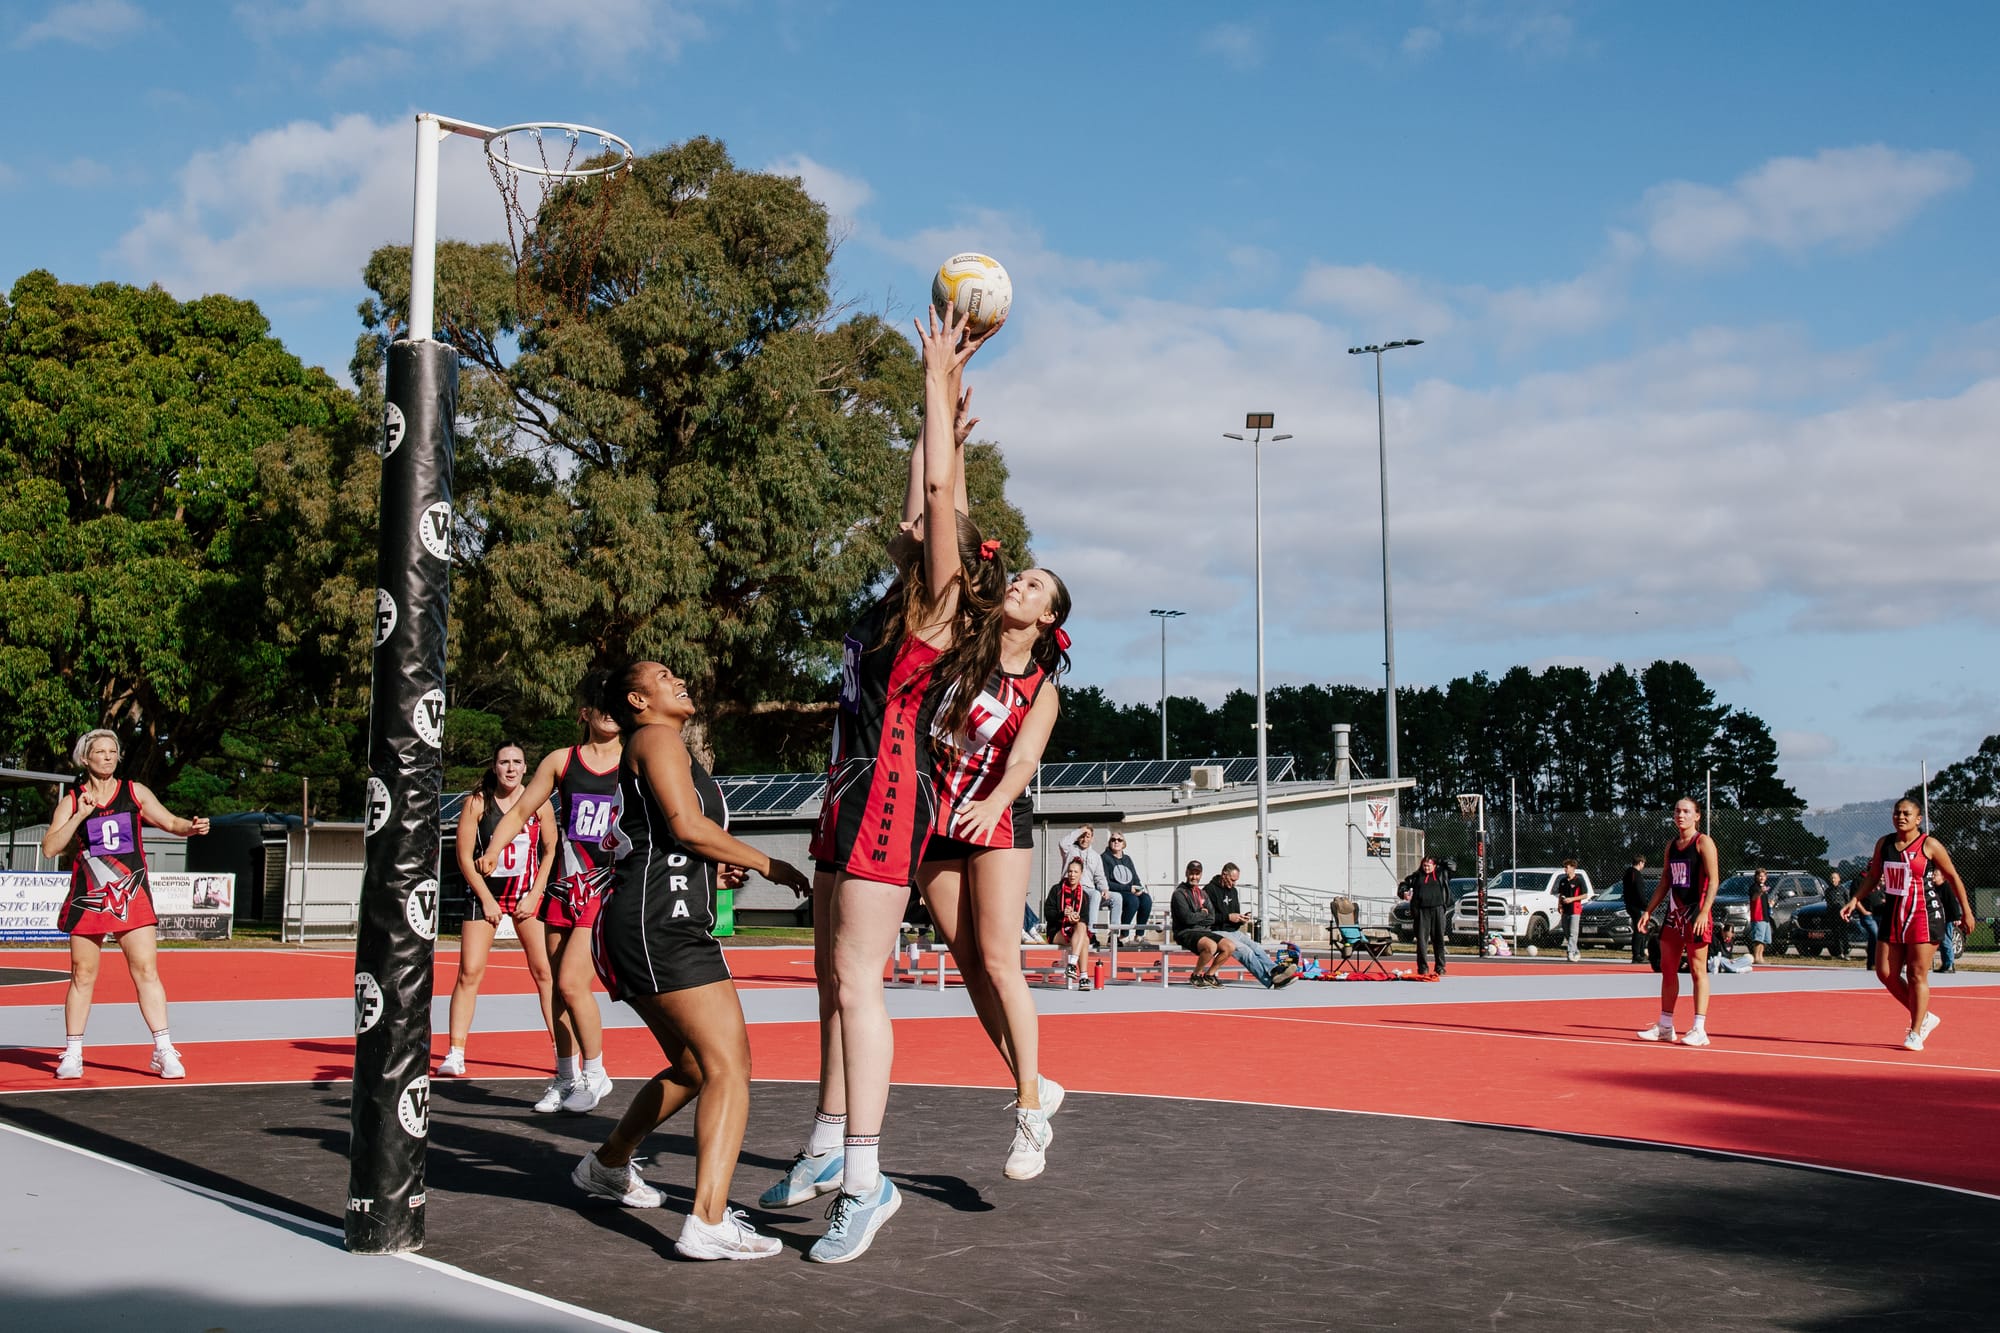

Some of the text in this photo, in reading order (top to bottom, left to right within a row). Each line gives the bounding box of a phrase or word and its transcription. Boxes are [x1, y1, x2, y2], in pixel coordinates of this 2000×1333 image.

[384, 412, 401, 453] F
[376, 599, 393, 641] F
[368, 787, 386, 831] F
[575, 799, 611, 837] GA
[871, 770, 899, 863] DARNUM
[101, 819, 120, 851] C
[503, 842, 516, 870] C
[1670, 862, 1687, 885] WD
[14, 876, 71, 887] TRANSPO
[16, 890, 24, 898] &
[667, 853, 691, 918] ORA
[157, 917, 171, 929] IKE
[173, 916, 186, 929] NO
